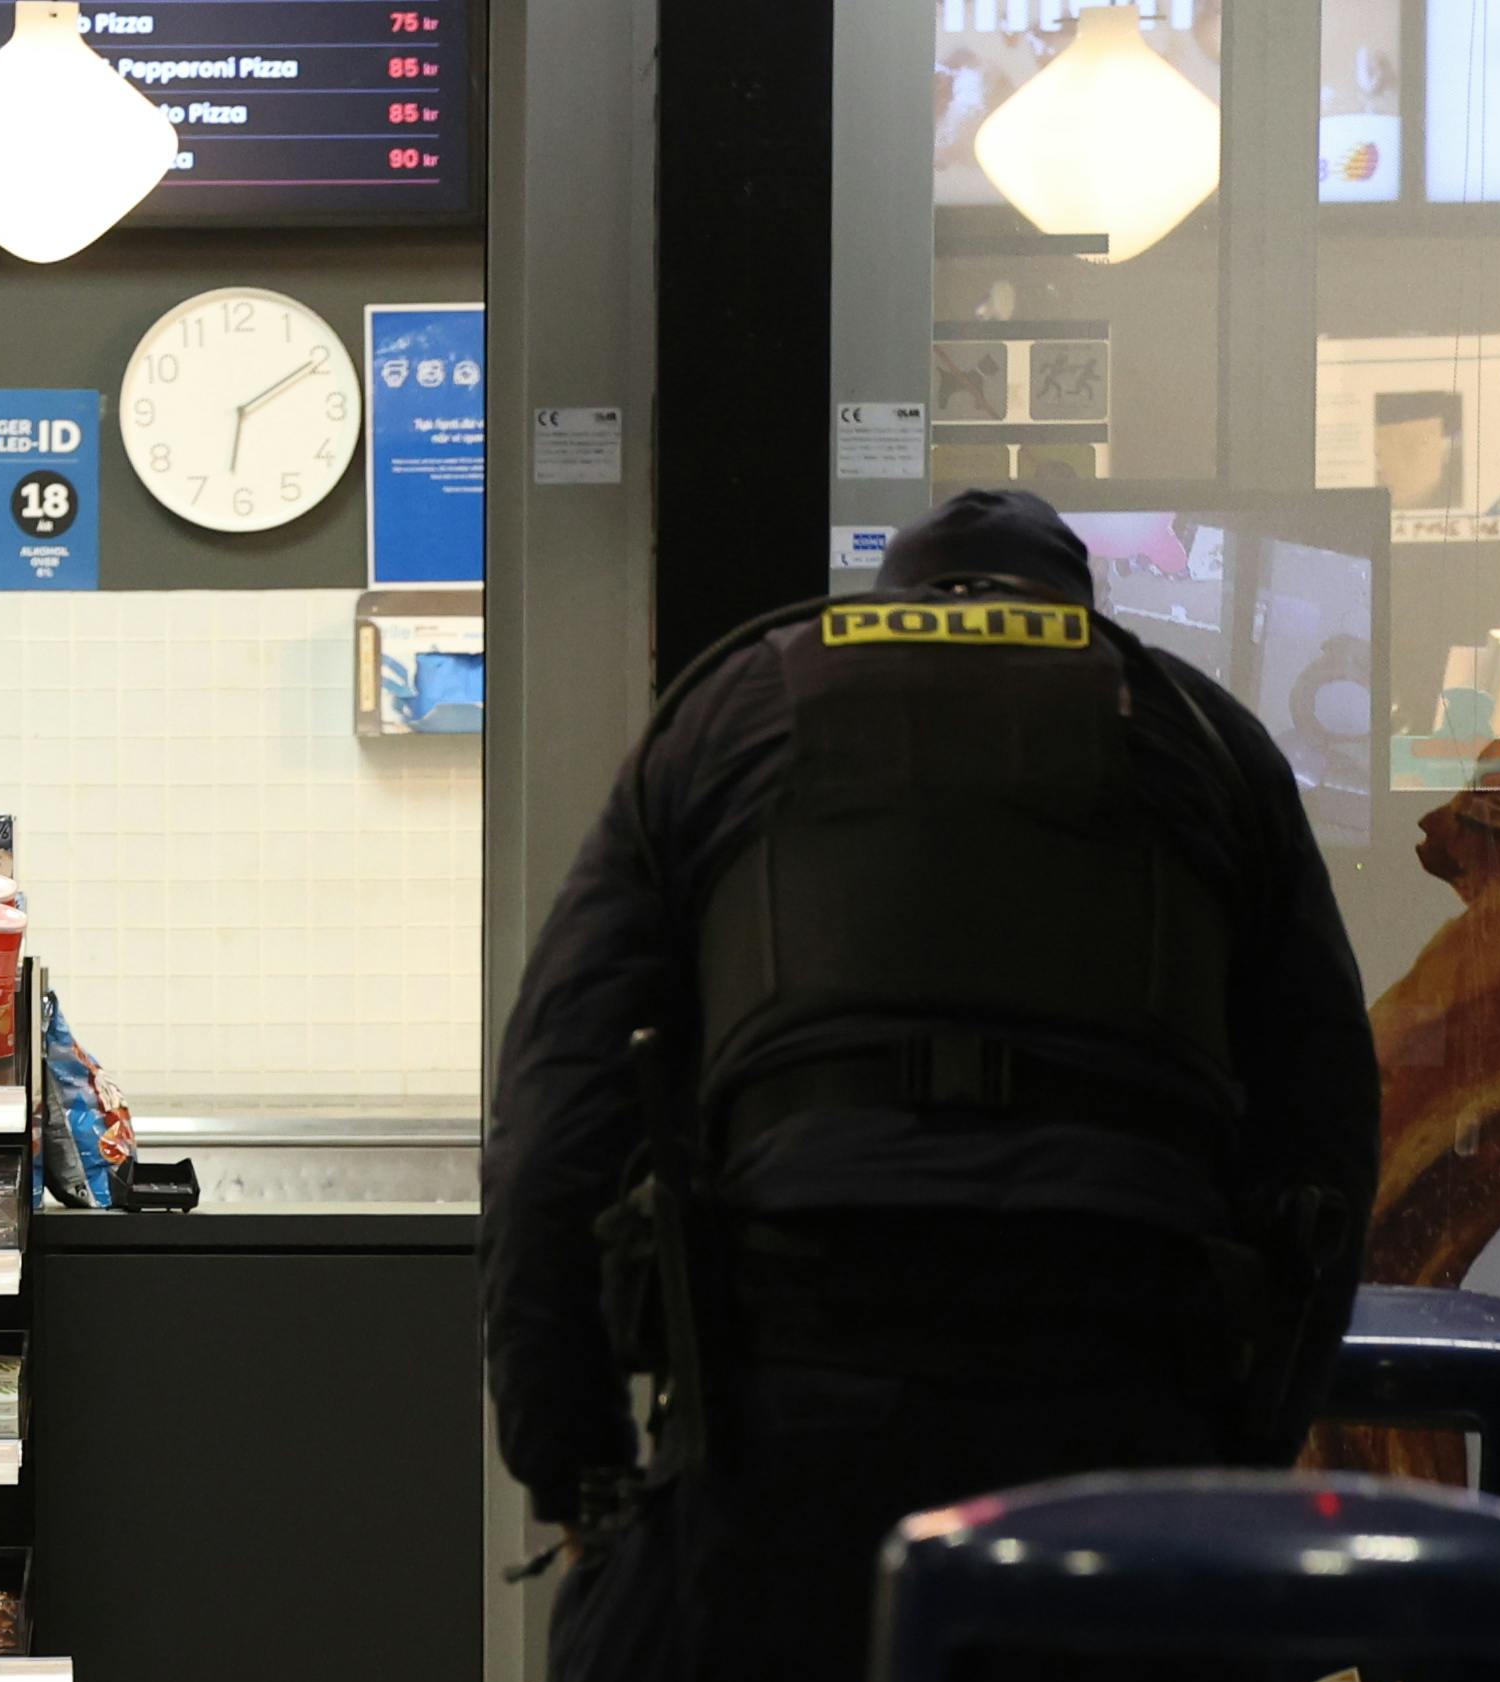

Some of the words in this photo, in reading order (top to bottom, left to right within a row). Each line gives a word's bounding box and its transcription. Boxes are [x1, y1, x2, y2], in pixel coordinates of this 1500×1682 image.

[95, 13, 153, 34] Pizza
[391, 13, 419, 32] 75
[119, 58, 235, 83] Pepperoni
[239, 59, 298, 80] Pizza
[389, 60, 419, 77] 85
[188, 103, 247, 124] Pizza
[389, 105, 419, 123] 85
[389, 150, 419, 168] 90
[178, 317, 204, 348] 11
[221, 302, 255, 334] 12
[281, 313, 292, 343] 1
[144, 353, 178, 384] 10
[309, 345, 331, 375] 2
[133, 398, 155, 428] 9
[325, 391, 347, 421] 3
[38, 419, 81, 453] ID
[150, 443, 171, 473] 8
[313, 437, 335, 467] 4
[20, 482, 70, 518] 18
[187, 476, 209, 506] 7
[232, 487, 254, 517] 6
[280, 472, 301, 502] 5
[829, 608, 1085, 643] POLITI
